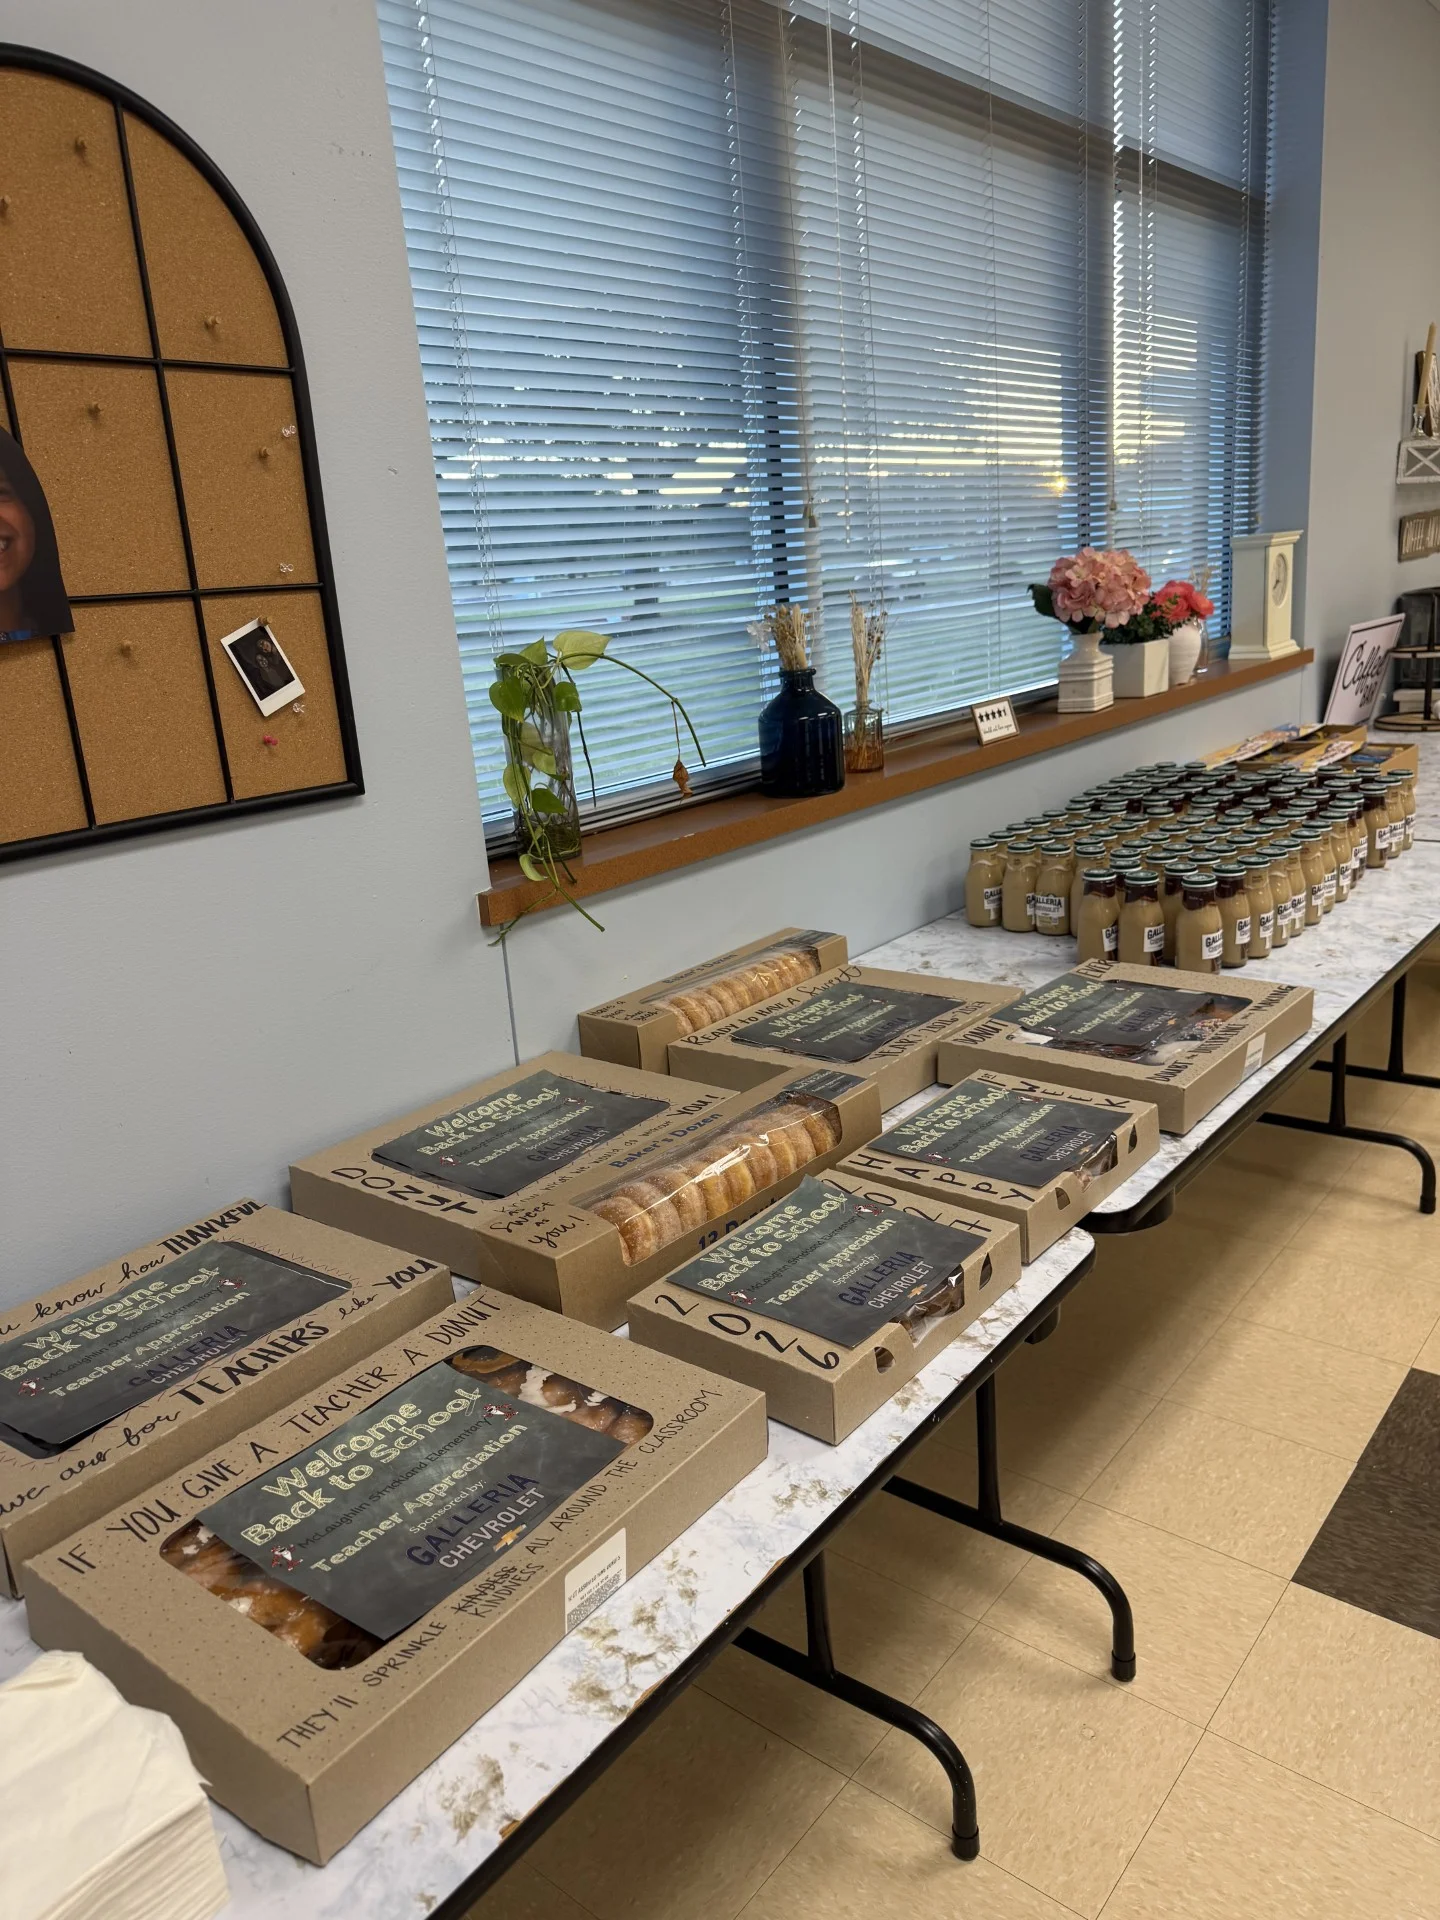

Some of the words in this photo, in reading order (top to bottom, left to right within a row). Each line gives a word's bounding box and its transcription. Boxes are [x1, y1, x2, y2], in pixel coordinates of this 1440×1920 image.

[681, 1023, 736, 1046] READY
[758, 1001, 789, 1020] HAVE
[787, 997, 802, 1005] A
[768, 998, 835, 1027] Welcome
[769, 1022, 808, 1038] Back
[802, 1015, 823, 1024] to
[815, 993, 864, 1016] School
[814, 1027, 850, 1043] Teacher
[847, 1004, 897, 1029] Appreciation
[1013, 984, 1074, 1012] Welcome
[1018, 1006, 1057, 1027] Back
[1050, 1000, 1068, 1011] to
[1067, 981, 1105, 1002] School
[952, 1019, 1009, 1046] DONUT
[416, 1130, 475, 1156] Back
[467, 1121, 496, 1133] to
[492, 1087, 561, 1122] School
[425, 1091, 522, 1138] Welcome
[467, 1141, 521, 1167] Teacher
[519, 1104, 594, 1144] Appreciation
[526, 1123, 605, 1163] GALLERIA
[609, 1138, 674, 1169] Baker's
[668, 1112, 724, 1138] Dozen
[894, 1093, 972, 1136] Welcome
[896, 1128, 946, 1154] Back
[935, 1119, 962, 1130] to
[952, 1087, 1010, 1121] School
[959, 1138, 1005, 1164] Teacher
[1002, 1104, 1057, 1142] Appreciation
[548, 1129, 611, 1161] CHEVROLET
[1019, 1125, 1084, 1163] GALLERIA
[1046, 1130, 1096, 1162] CHEVROLET
[331, 1167, 479, 1215] DONUT
[847, 1153, 1037, 1204] HAPPY
[490, 1201, 555, 1233] Sweet
[698, 1255, 760, 1291] Back
[749, 1241, 782, 1257] to
[774, 1192, 848, 1242] School
[700, 1204, 802, 1264] Welcome
[30, 1282, 106, 1322] know
[118, 1255, 166, 1284] how
[157, 1200, 268, 1257] THANKFUL
[765, 1269, 824, 1307] Teacher
[818, 1218, 897, 1273] Appreciation
[838, 1250, 924, 1307] GALLERIA
[867, 1260, 934, 1309] CHEVROLET
[0, 1338, 82, 1380] Back
[79, 1320, 118, 1341] to
[117, 1266, 220, 1321] School
[22, 1280, 169, 1350] Welcome
[42, 1345, 108, 1381] McLaughlin
[108, 1318, 162, 1349] Strickland
[161, 1285, 224, 1320] Elementary
[654, 1294, 840, 1370] 2026
[49, 1353, 133, 1398] Teacher
[135, 1291, 251, 1356] Appreciation
[60, 1449, 112, 1481] are
[116, 1411, 181, 1447] for
[170, 1320, 331, 1406] TEACHERS
[338, 1293, 379, 1320] like
[371, 1259, 439, 1291] YOU
[127, 1324, 248, 1389] GALLERIA
[134, 1336, 190, 1370] Sponsored
[151, 1333, 248, 1385] CHEVROLET
[57, 1543, 97, 1575] IF
[106, 1500, 183, 1545] YOU
[182, 1459, 245, 1501] GIVE
[250, 1440, 279, 1463] A
[280, 1365, 398, 1435] TEACHER
[407, 1349, 429, 1366] A
[425, 1295, 502, 1346] DONUT
[261, 1403, 422, 1497] Welcome
[241, 1487, 335, 1546] Back
[328, 1464, 374, 1491] to
[370, 1387, 482, 1464] School
[297, 1501, 371, 1549] McLaughlin
[369, 1461, 428, 1502] Strickland
[427, 1417, 493, 1463] Elementary
[310, 1512, 403, 1573] Teacher
[402, 1422, 528, 1515] Appreciation
[406, 1473, 540, 1567] GALLERIA
[408, 1490, 469, 1535] Sponsored
[466, 1479, 488, 1499] by:
[362, 1620, 448, 1687] SPRINKLE
[525, 1535, 555, 1555] ALL
[550, 1483, 608, 1532] AROUND
[604, 1459, 638, 1479] THE
[638, 1389, 723, 1455] CLASSROOM
[438, 1487, 545, 1569] CHEVROLET
[468, 1563, 545, 1619] KINDNESS
